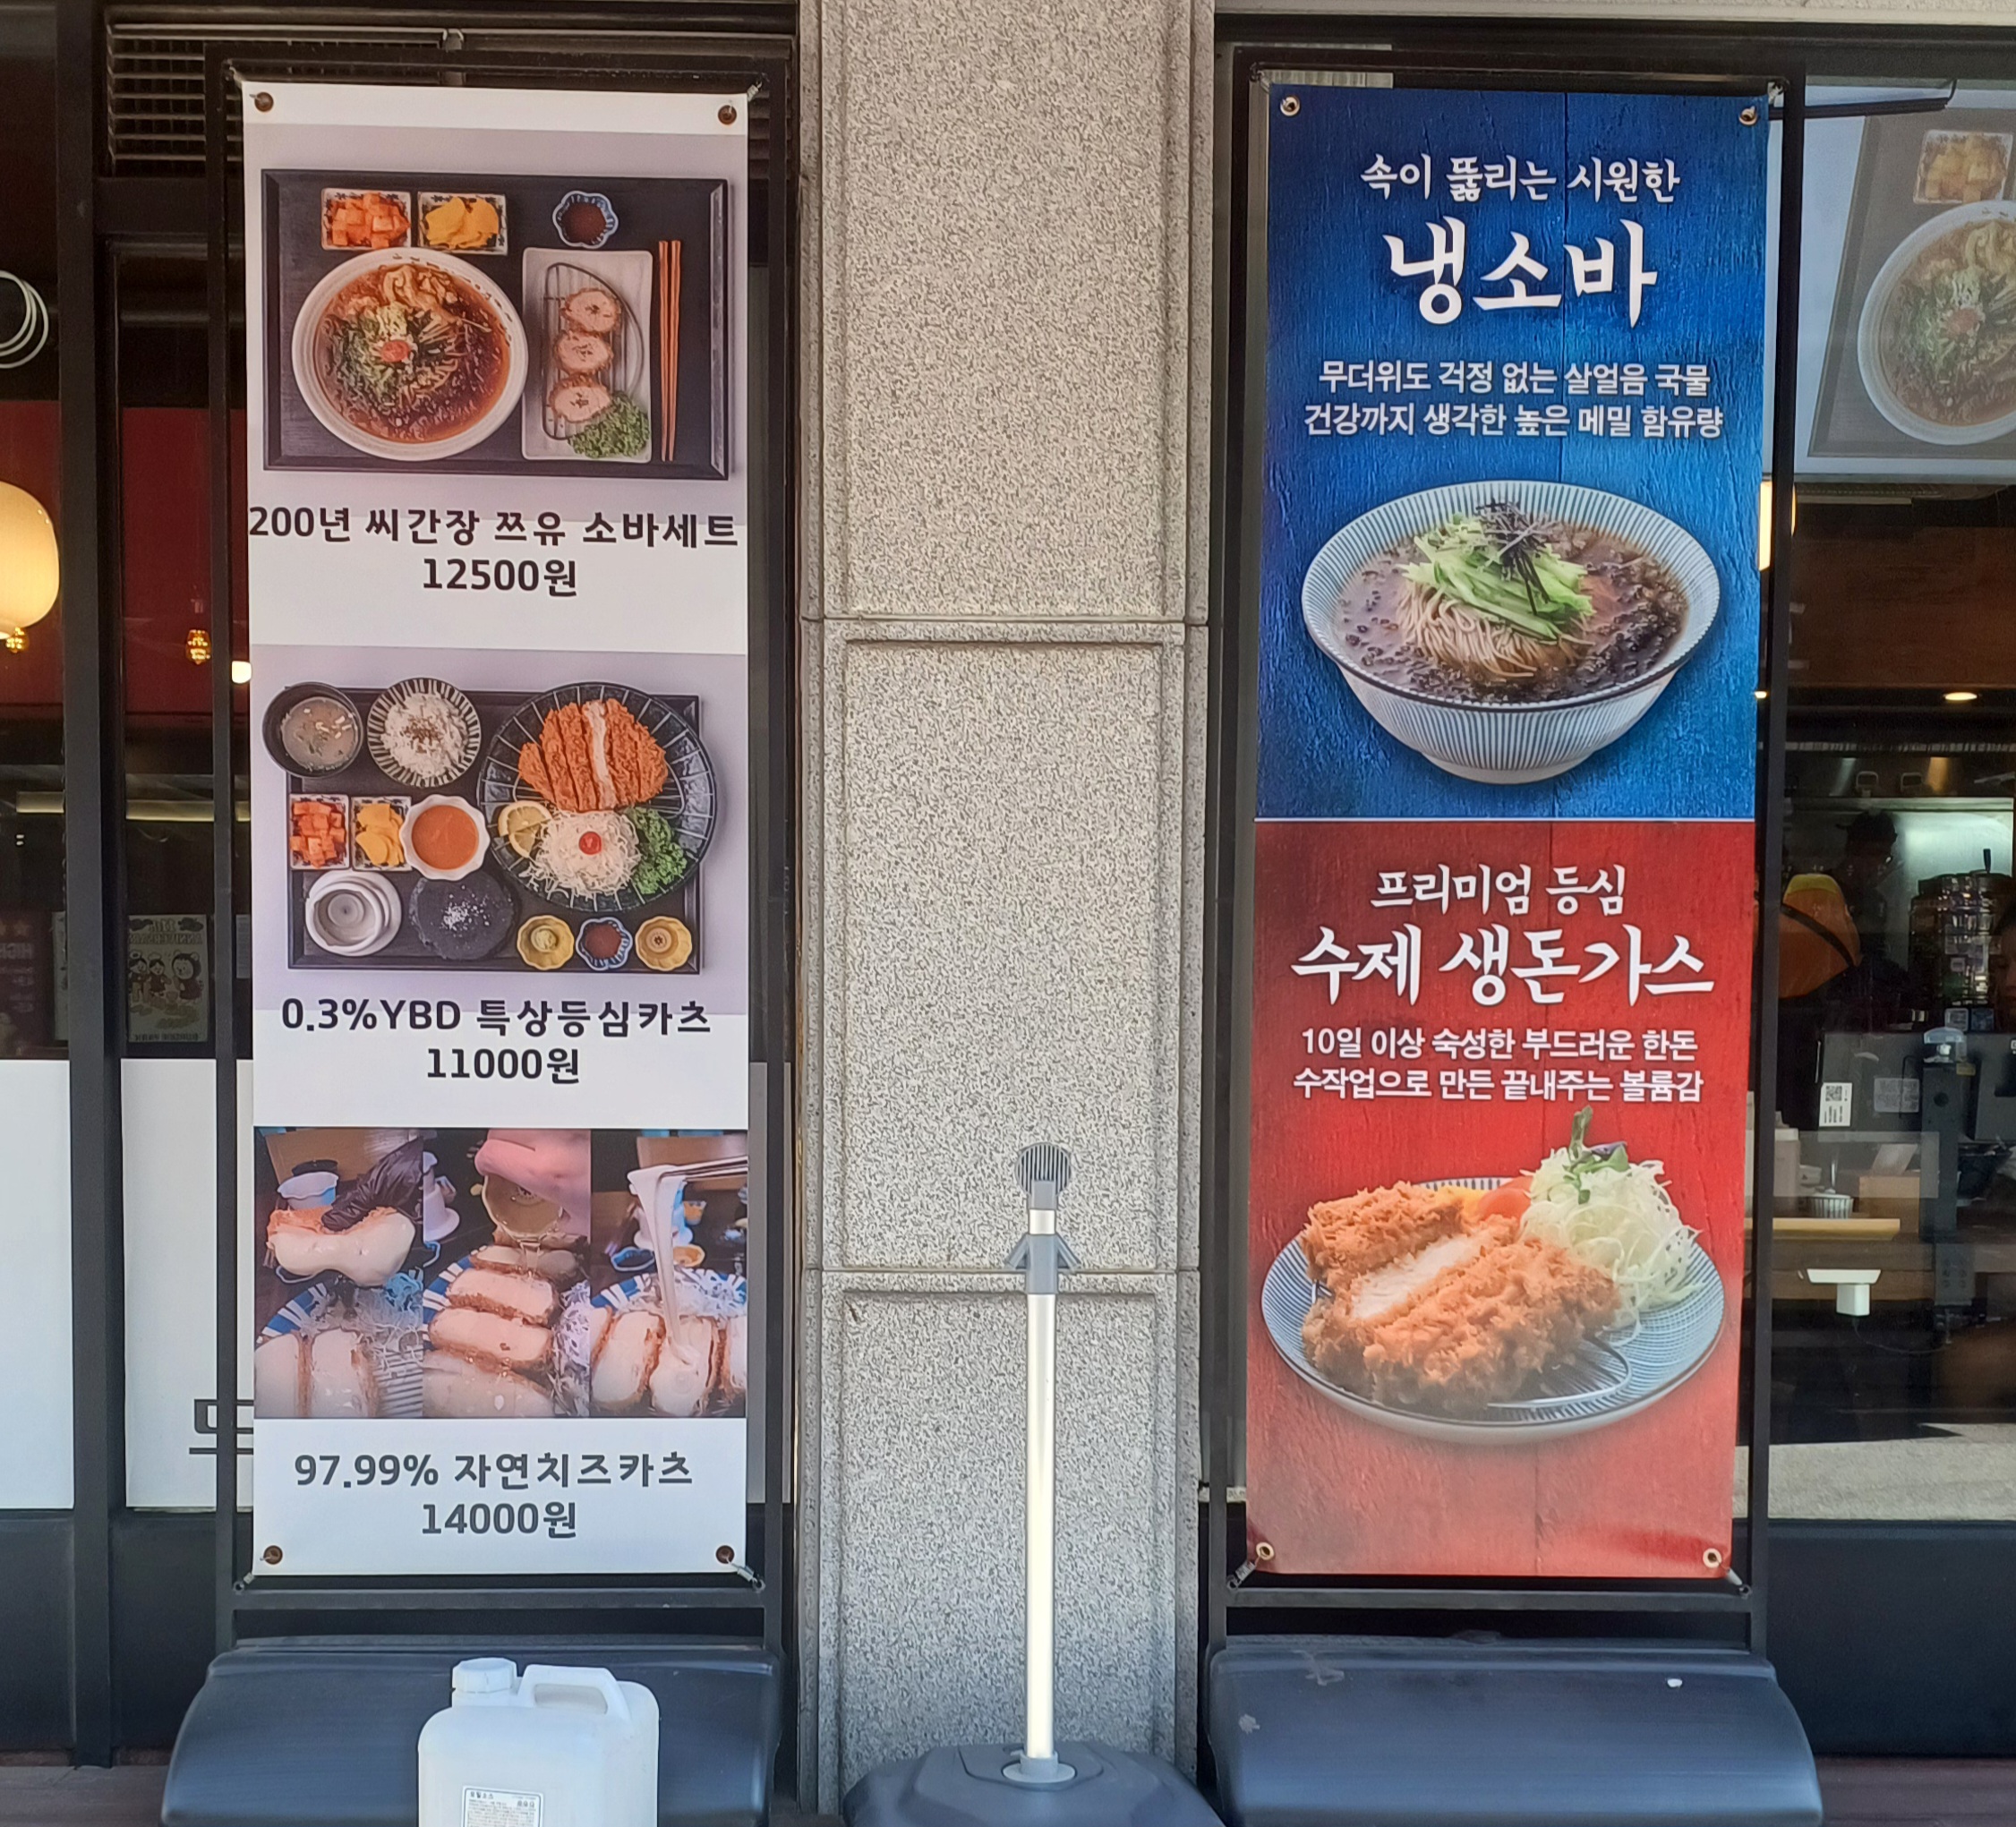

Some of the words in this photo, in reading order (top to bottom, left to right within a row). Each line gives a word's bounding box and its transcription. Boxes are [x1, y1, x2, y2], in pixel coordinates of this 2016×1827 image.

[1361, 153, 1431, 201] 속이
[1446, 155, 1557, 203] 뚫리는
[1567, 157, 1681, 203] 시원한
[1382, 215, 1659, 329] 냉소바
[1319, 360, 1432, 394] 무더위도
[1439, 361, 1493, 394] 걱정
[1502, 362, 1558, 394] 없는
[1564, 363, 1649, 396] 살얼음
[1654, 364, 1712, 397] 국물
[1304, 402, 1415, 436] 건강까지
[1422, 403, 1508, 436] 생각한
[1514, 405, 1571, 437] 높은
[1578, 405, 1632, 437] 메밀
[1641, 406, 1724, 439] 함유량
[249, 507, 351, 542] 200년
[364, 508, 481, 546] 씨간장
[494, 511, 567, 547] 쯔유
[582, 511, 739, 549] 소바세트
[422, 558, 577, 598] 12500원
[1370, 863, 1532, 917] 프리미엄
[1545, 864, 1626, 917] 등심
[1290, 923, 1422, 1006] 수제
[1439, 923, 1715, 1007] 생돈가스
[282, 997, 461, 1032] 0.3%YBD
[476, 999, 712, 1037] 특상등심카츠
[1302, 1027, 1362, 1059] 10일
[1371, 1027, 1426, 1060] 이상
[1431, 1028, 1516, 1060] 숙성한
[1522, 1029, 1636, 1062] 부드러운
[1642, 1029, 1699, 1062] 한돈
[427, 1047, 579, 1085] 11000원
[1293, 1067, 1433, 1099] 수작업으로
[1439, 1068, 1495, 1100] 만든
[1500, 1069, 1615, 1101] 끝내주는
[1619, 1070, 1704, 1103] 볼륨감
[295, 1454, 439, 1489] 97.99%
[454, 1451, 693, 1490] 자연치즈카츠
[422, 1501, 577, 1539] 14000원
